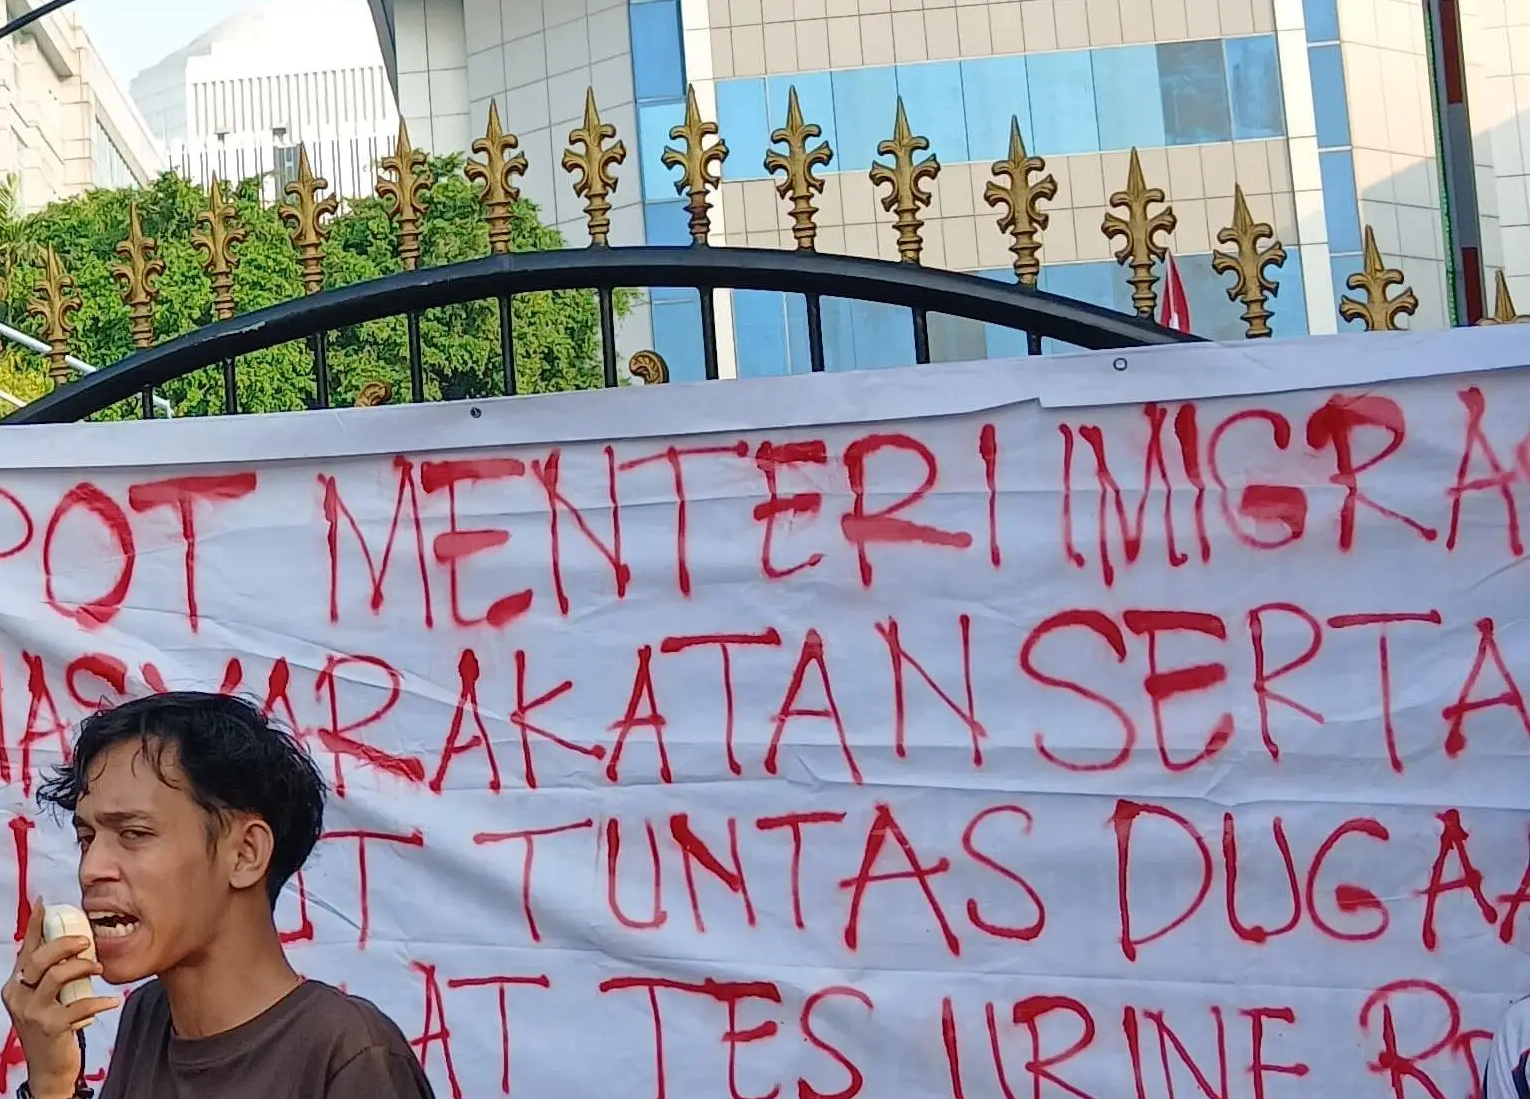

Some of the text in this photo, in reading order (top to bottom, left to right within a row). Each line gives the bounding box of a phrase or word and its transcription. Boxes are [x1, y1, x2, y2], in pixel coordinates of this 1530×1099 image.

[315, 422, 1002, 631] MENTERI
[1058, 386, 1530, 590] IMIGRA
[1018, 602, 1530, 775] SERTA
[473, 802, 1047, 958] TUNTAS
